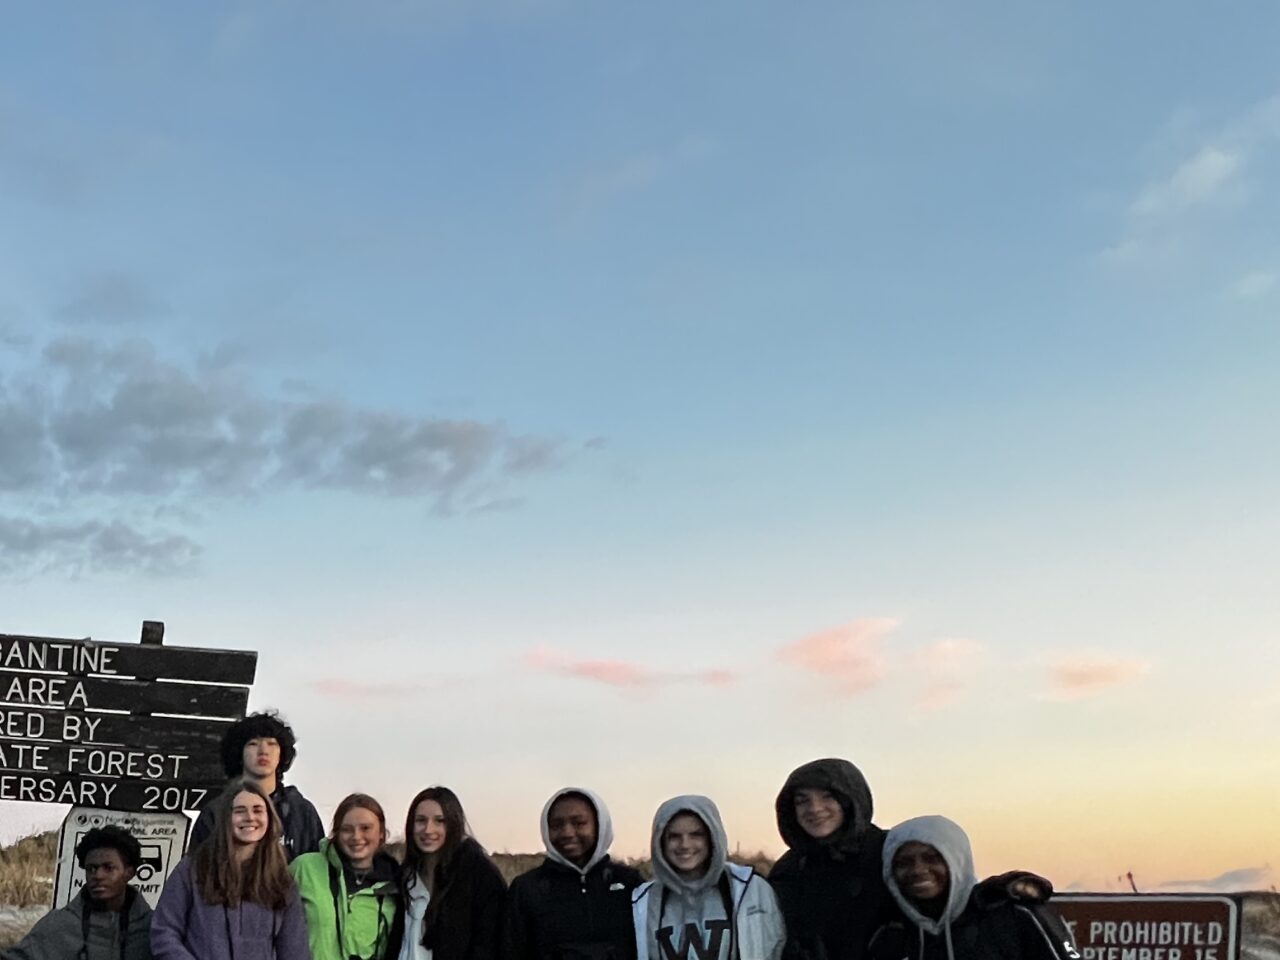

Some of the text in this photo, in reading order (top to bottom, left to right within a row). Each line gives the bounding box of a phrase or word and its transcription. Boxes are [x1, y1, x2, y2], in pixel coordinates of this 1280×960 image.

[5, 677, 88, 707] AREA
[62, 715, 101, 741] BY
[68, 748, 189, 779] FOREST
[142, 786, 208, 811] 2017
[151, 827, 177, 836] AREA
[1089, 921, 1223, 945] PROHIBITED
